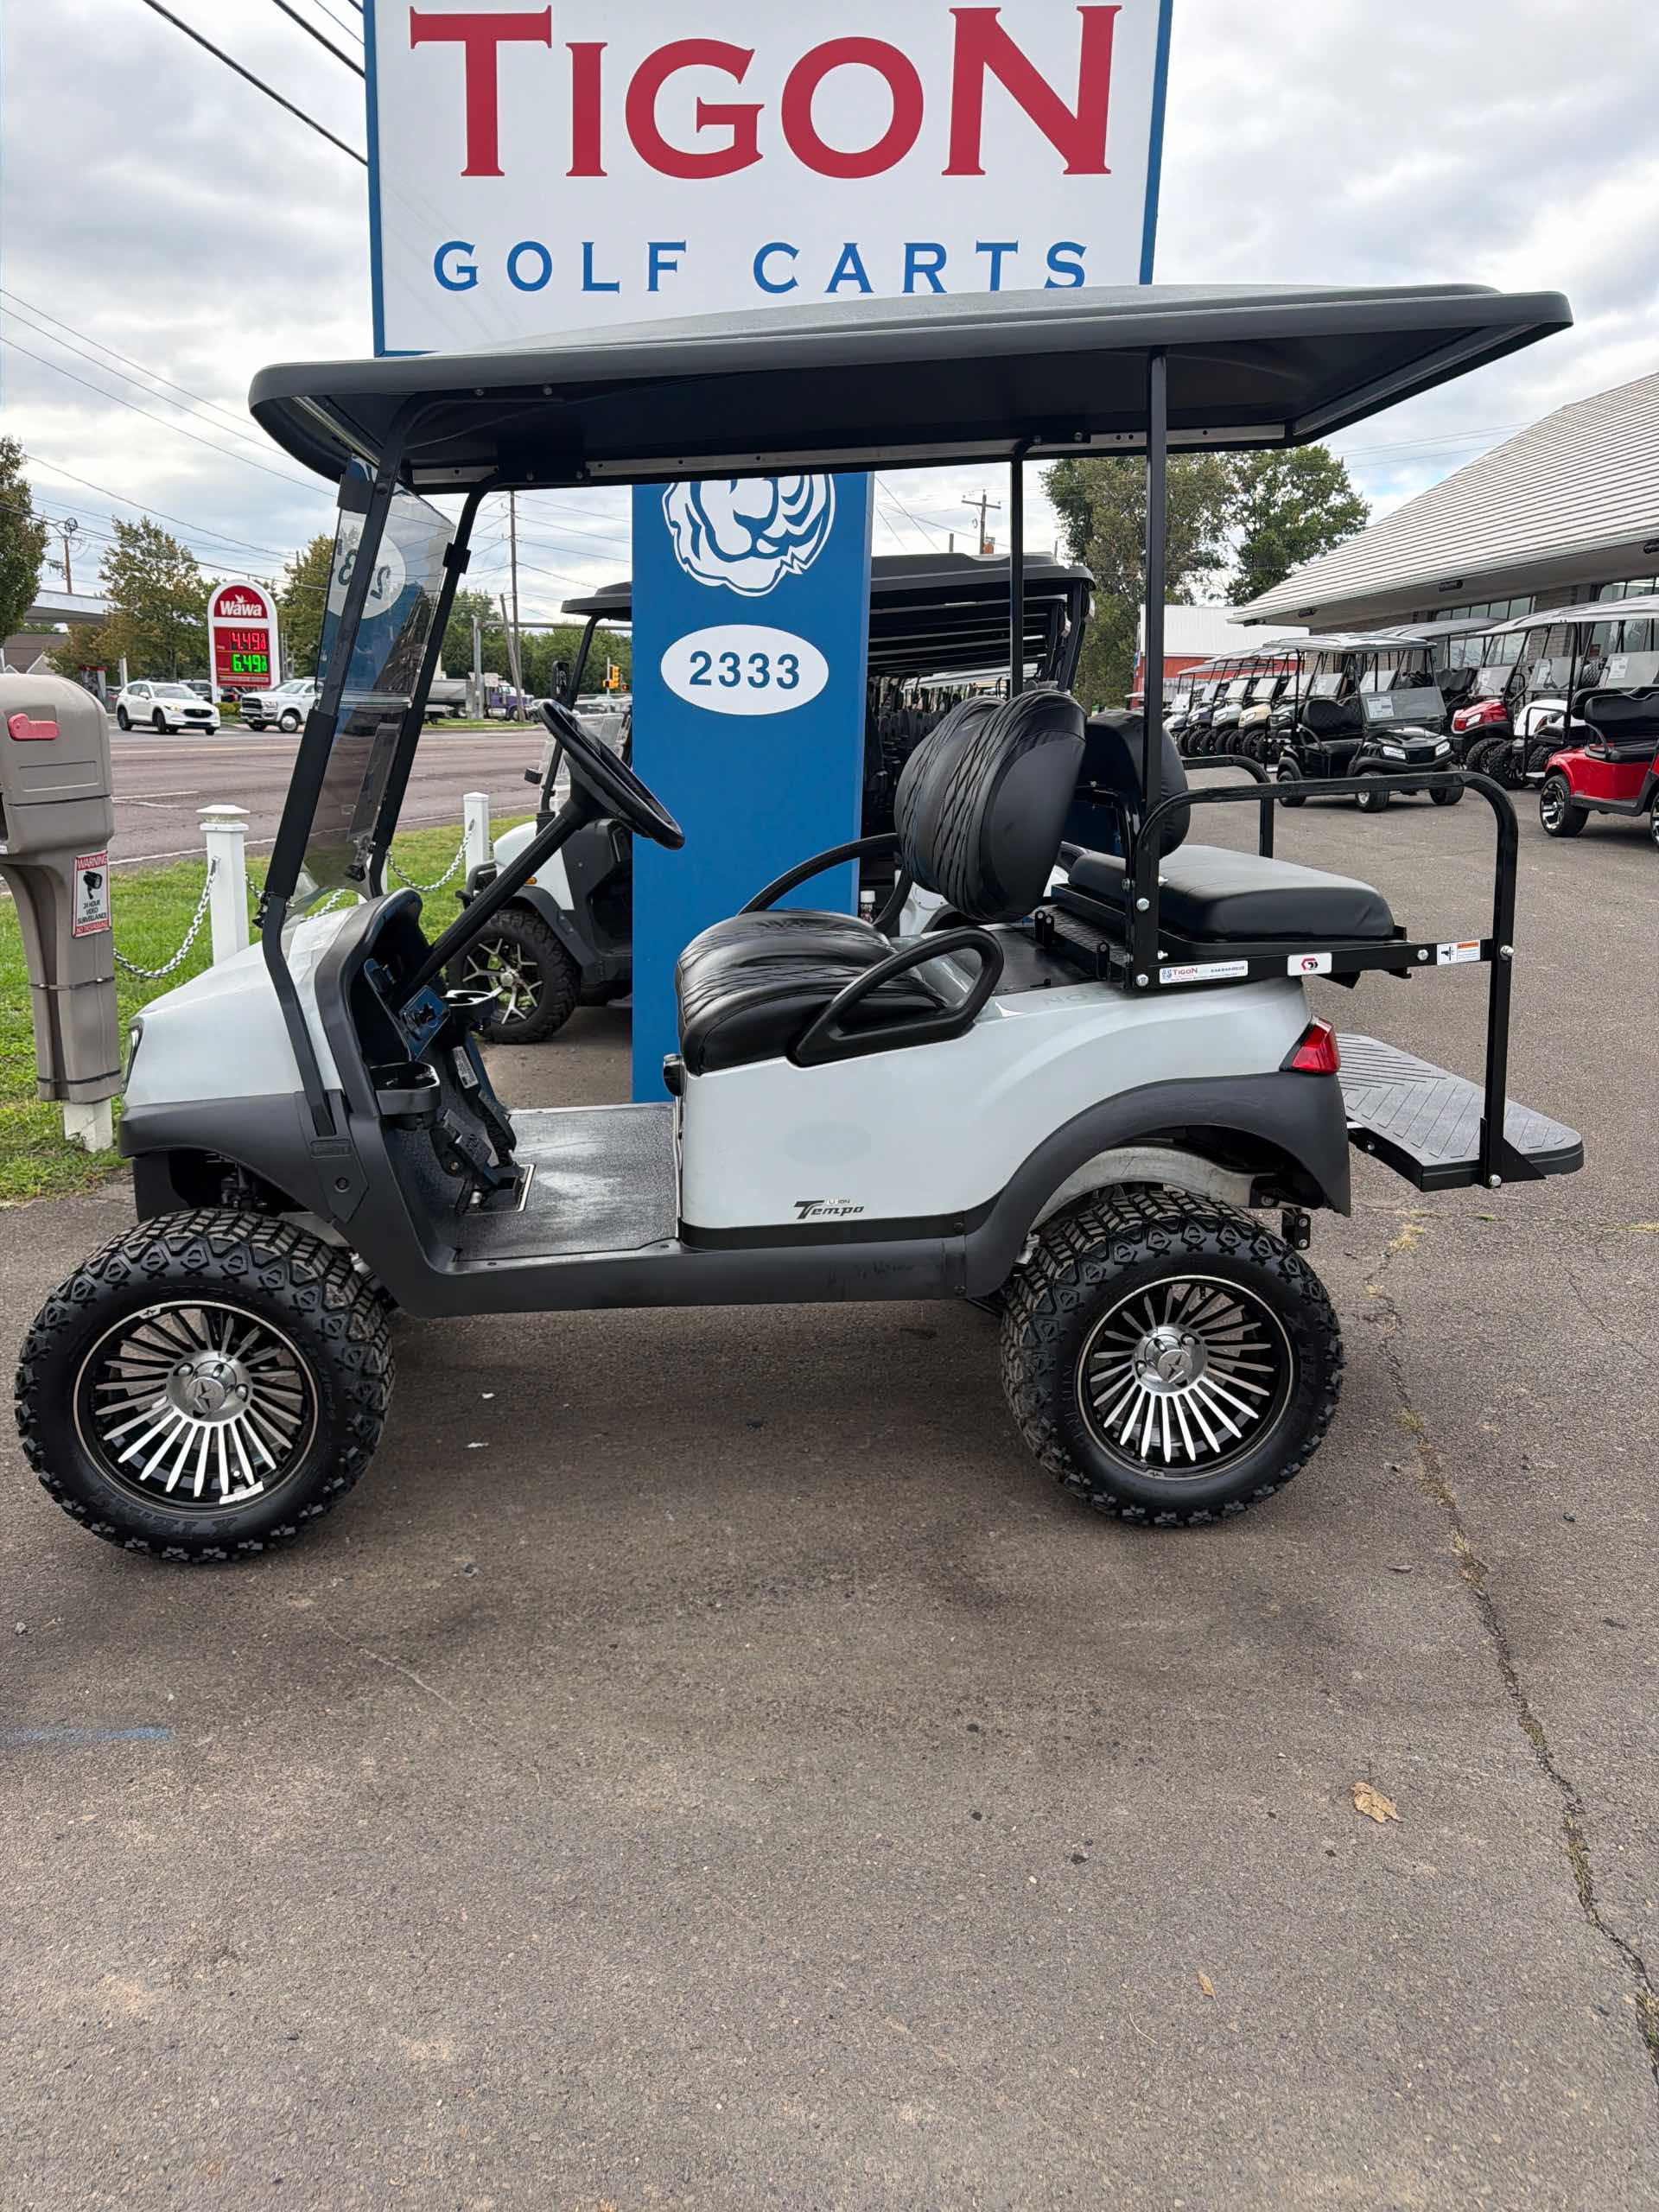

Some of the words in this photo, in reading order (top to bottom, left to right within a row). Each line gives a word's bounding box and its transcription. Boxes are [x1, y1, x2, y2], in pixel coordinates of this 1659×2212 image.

[410, 4, 1122, 179] TIGON
[433, 239, 687, 294] GOLF
[753, 239, 1088, 294] CARTS
[219, 600, 262, 617] Wawa
[689, 650, 800, 690] 2333
[78, 854, 107, 869] WARNING
[793, 1199, 865, 1220] Tempo
